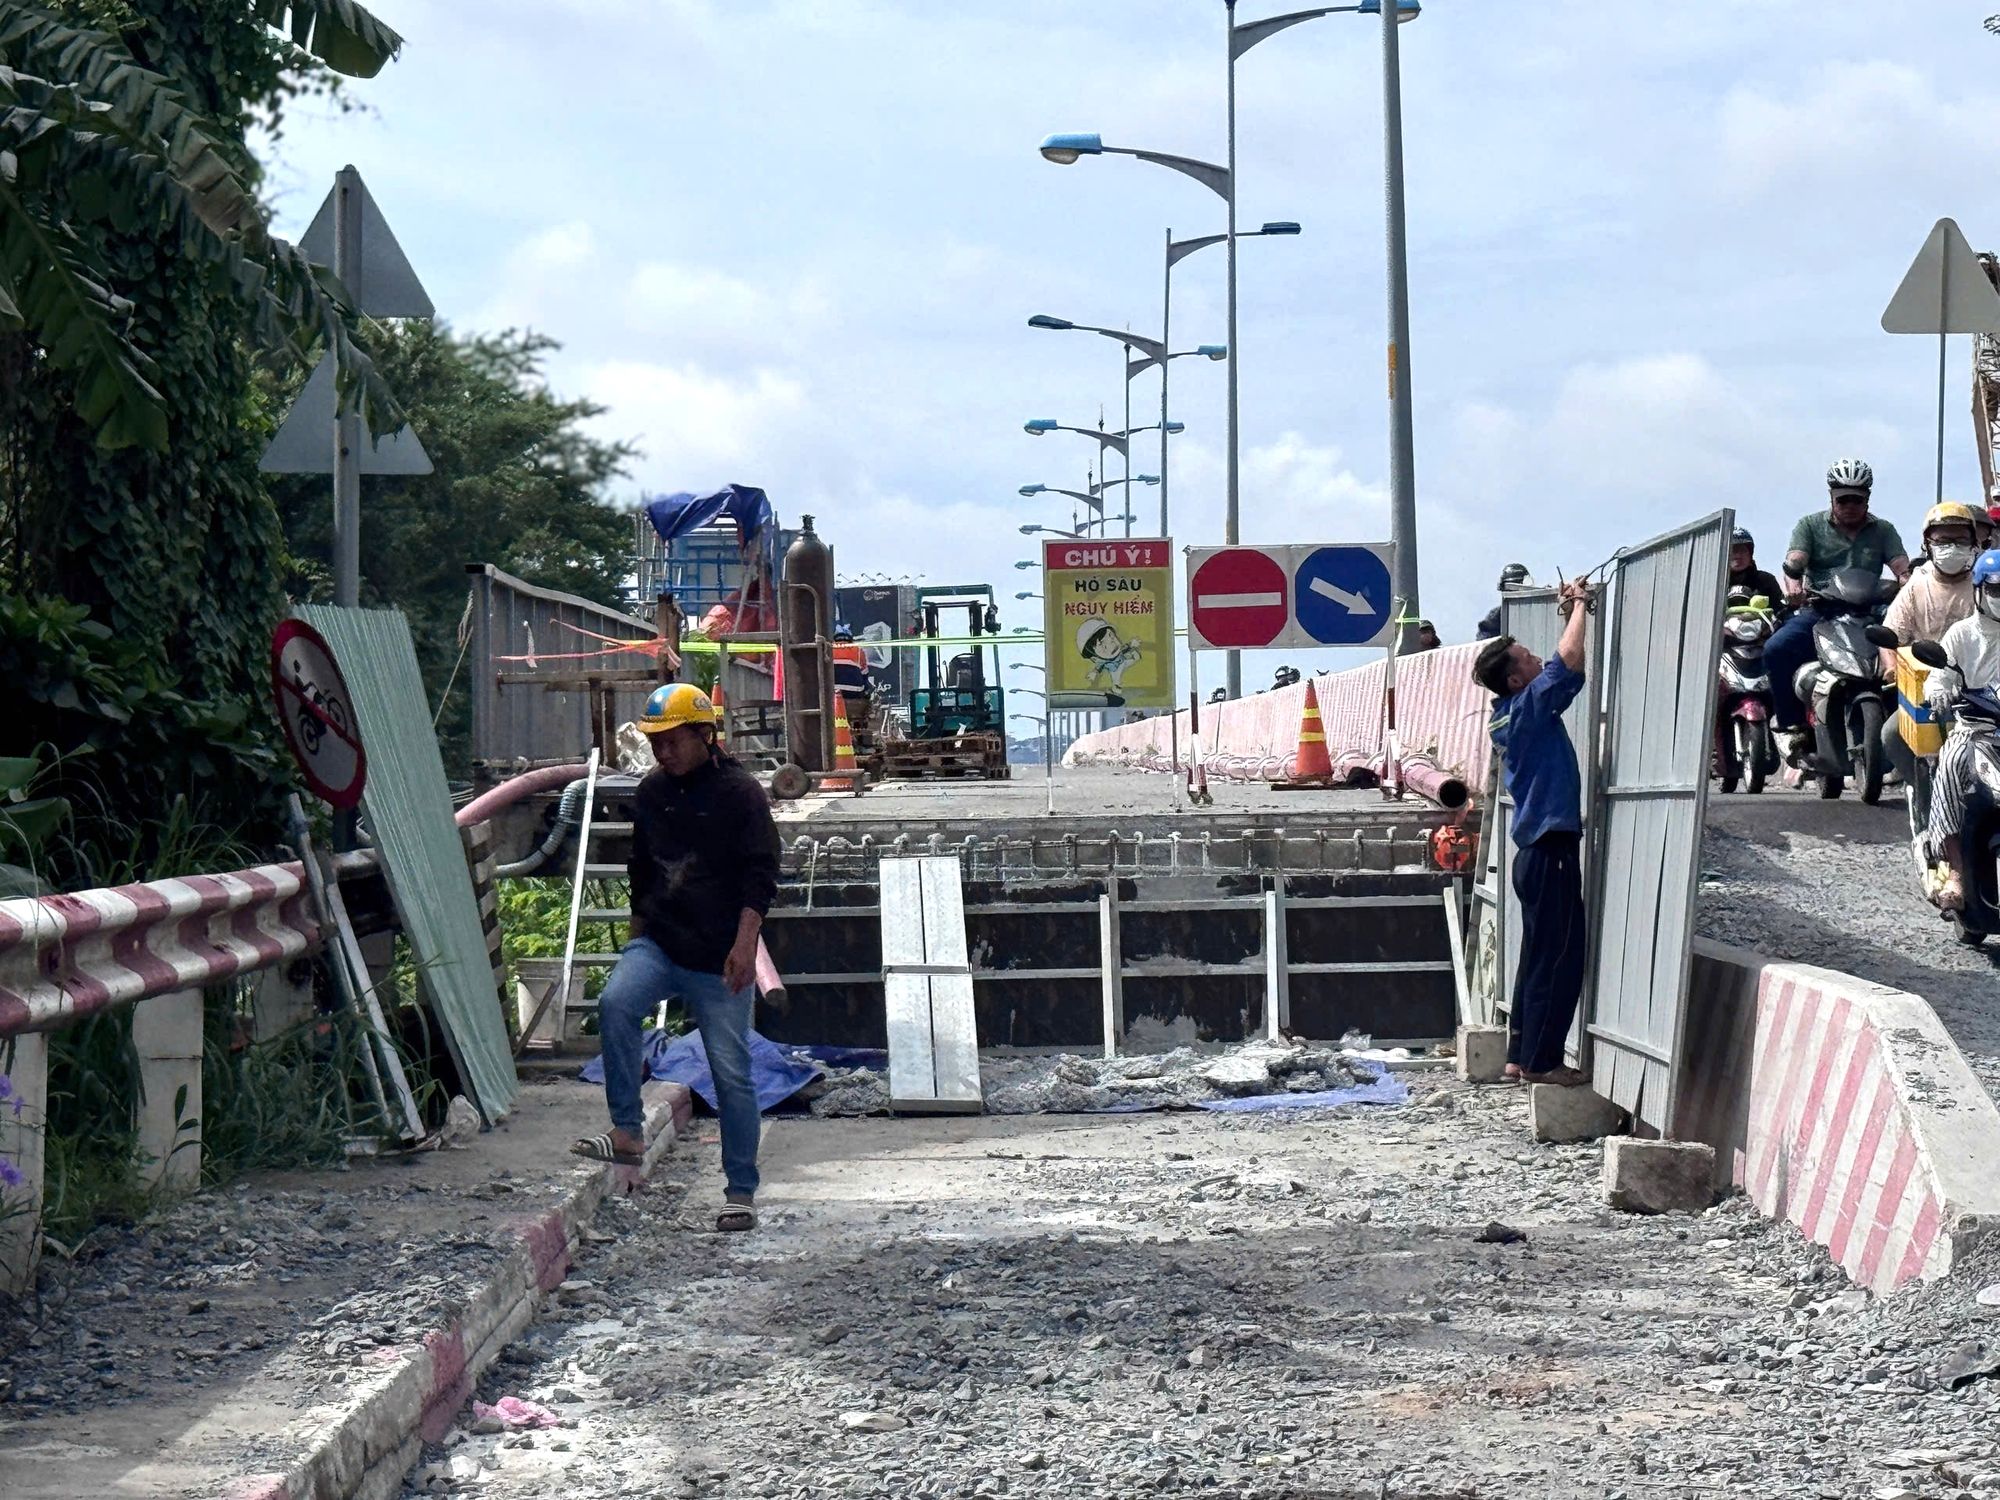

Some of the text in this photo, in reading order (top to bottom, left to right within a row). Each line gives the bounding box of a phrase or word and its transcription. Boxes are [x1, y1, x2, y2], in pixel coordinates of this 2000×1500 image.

[1064, 545, 1117, 566] CHÚ
[1106, 576, 1142, 592] SÂU
[1064, 602, 1108, 616] NGUY
